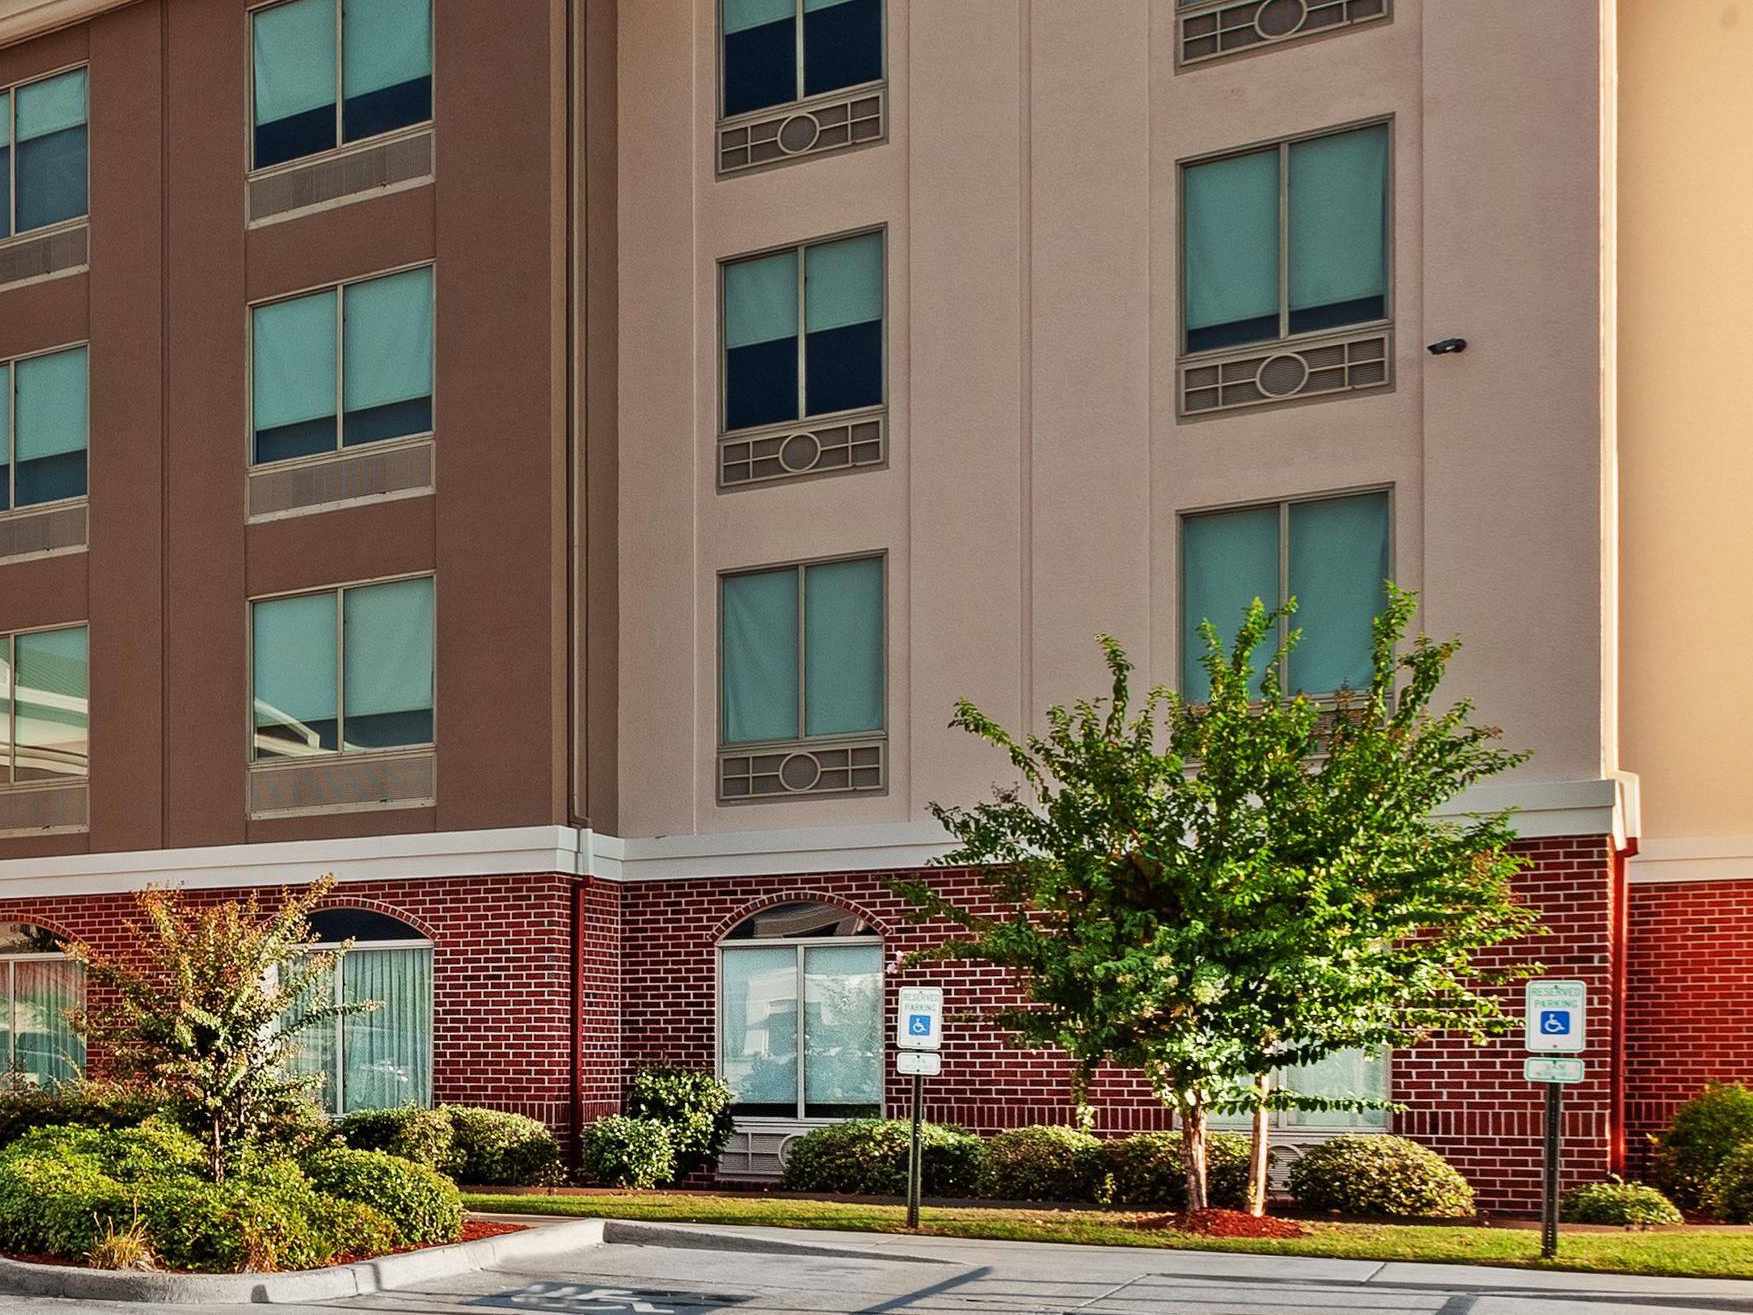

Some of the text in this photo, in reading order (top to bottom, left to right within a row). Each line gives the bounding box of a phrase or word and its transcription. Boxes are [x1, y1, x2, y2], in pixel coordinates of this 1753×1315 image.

[1530, 987, 1581, 997] RESERVED
[903, 993, 940, 1002] RESERVED
[904, 1003, 938, 1012] PARKING
[1534, 999, 1579, 1008] PARKING
